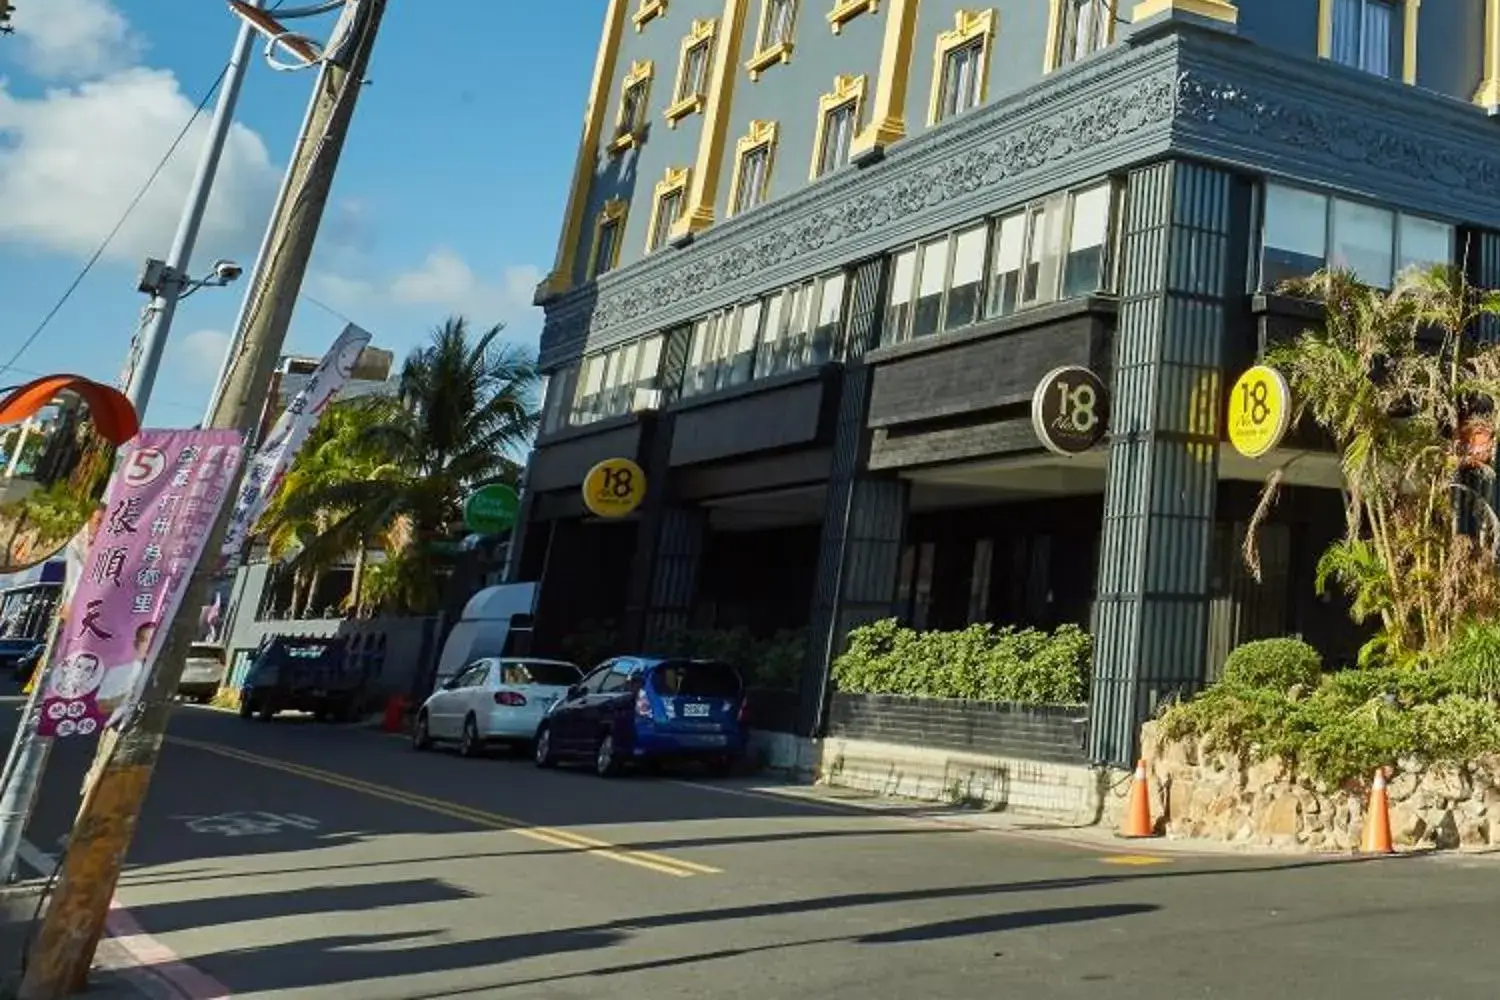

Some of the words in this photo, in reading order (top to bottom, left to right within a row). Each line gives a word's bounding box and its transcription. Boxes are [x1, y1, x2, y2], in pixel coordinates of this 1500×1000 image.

[1057, 381, 1099, 431] 18
[1242, 380, 1270, 425] 18
[127, 449, 158, 481] 5
[602, 467, 634, 497] 18
